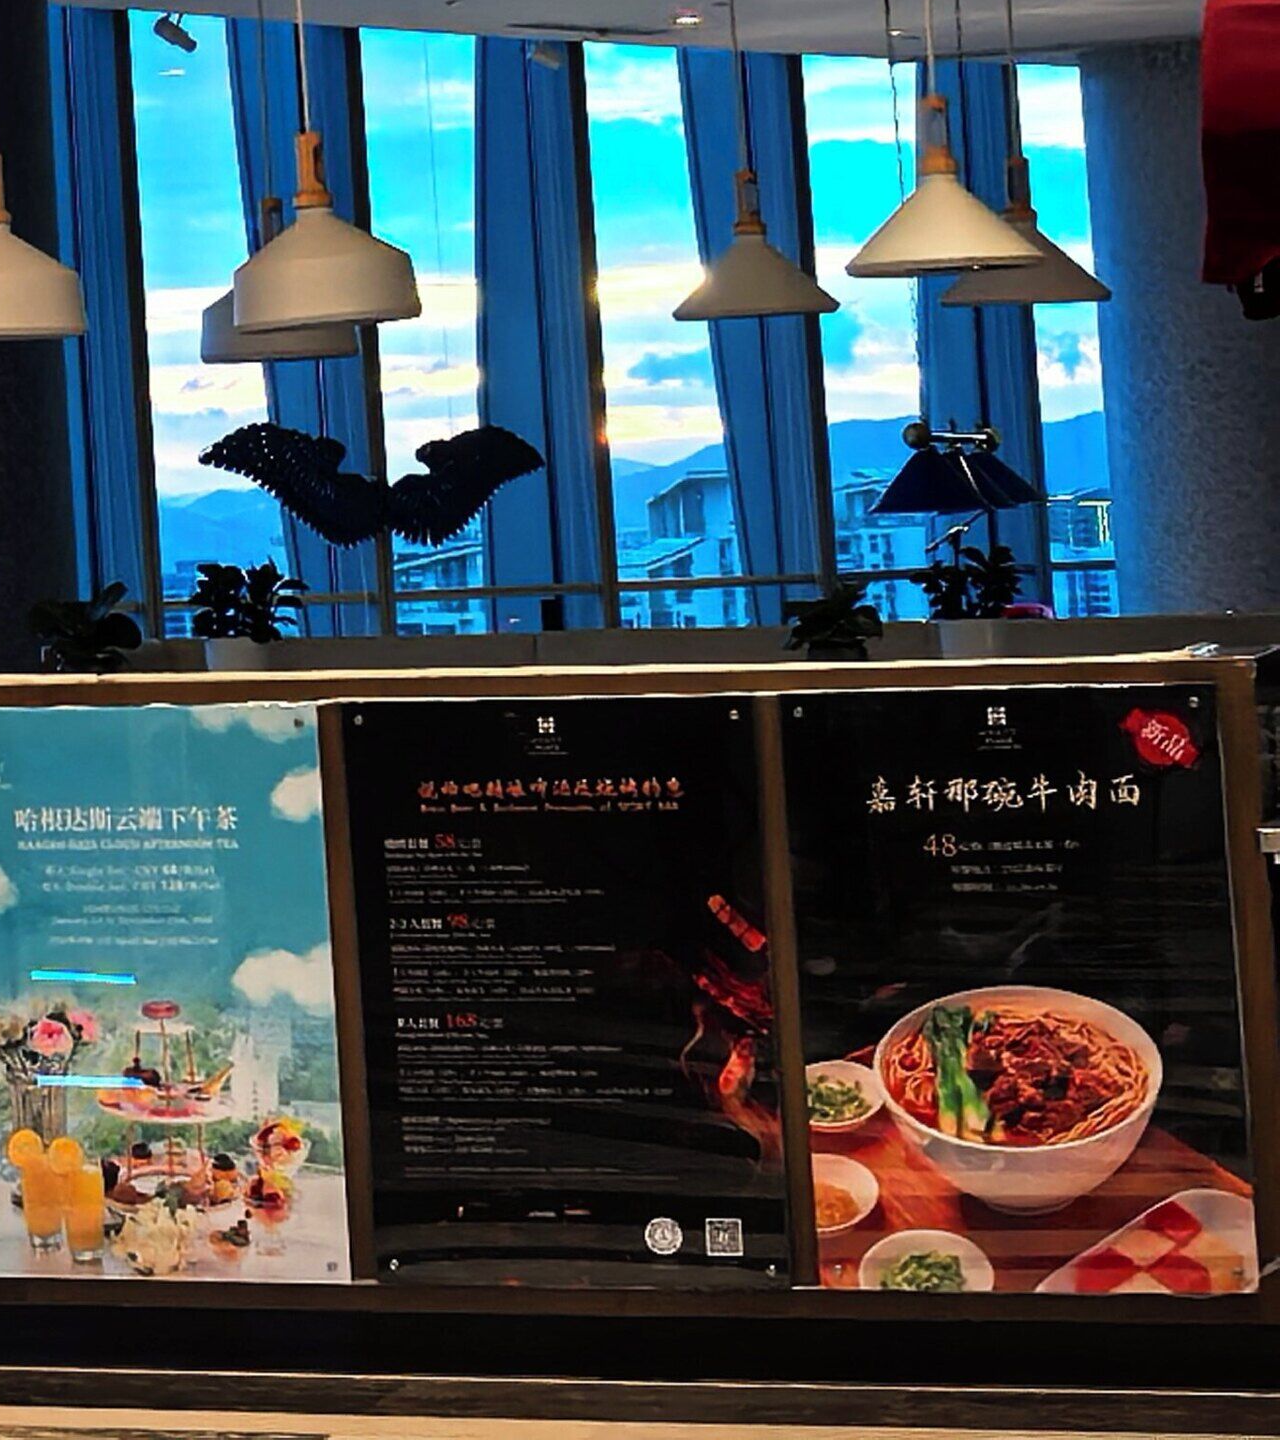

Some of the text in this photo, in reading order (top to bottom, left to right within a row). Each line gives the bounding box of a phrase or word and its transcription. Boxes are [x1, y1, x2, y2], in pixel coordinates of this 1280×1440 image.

[1140, 719, 1185, 761] 新品
[866, 770, 1140, 812] 嘉轩那碗牛肉面
[13, 805, 238, 833] 哈根达斯云端下午茶
